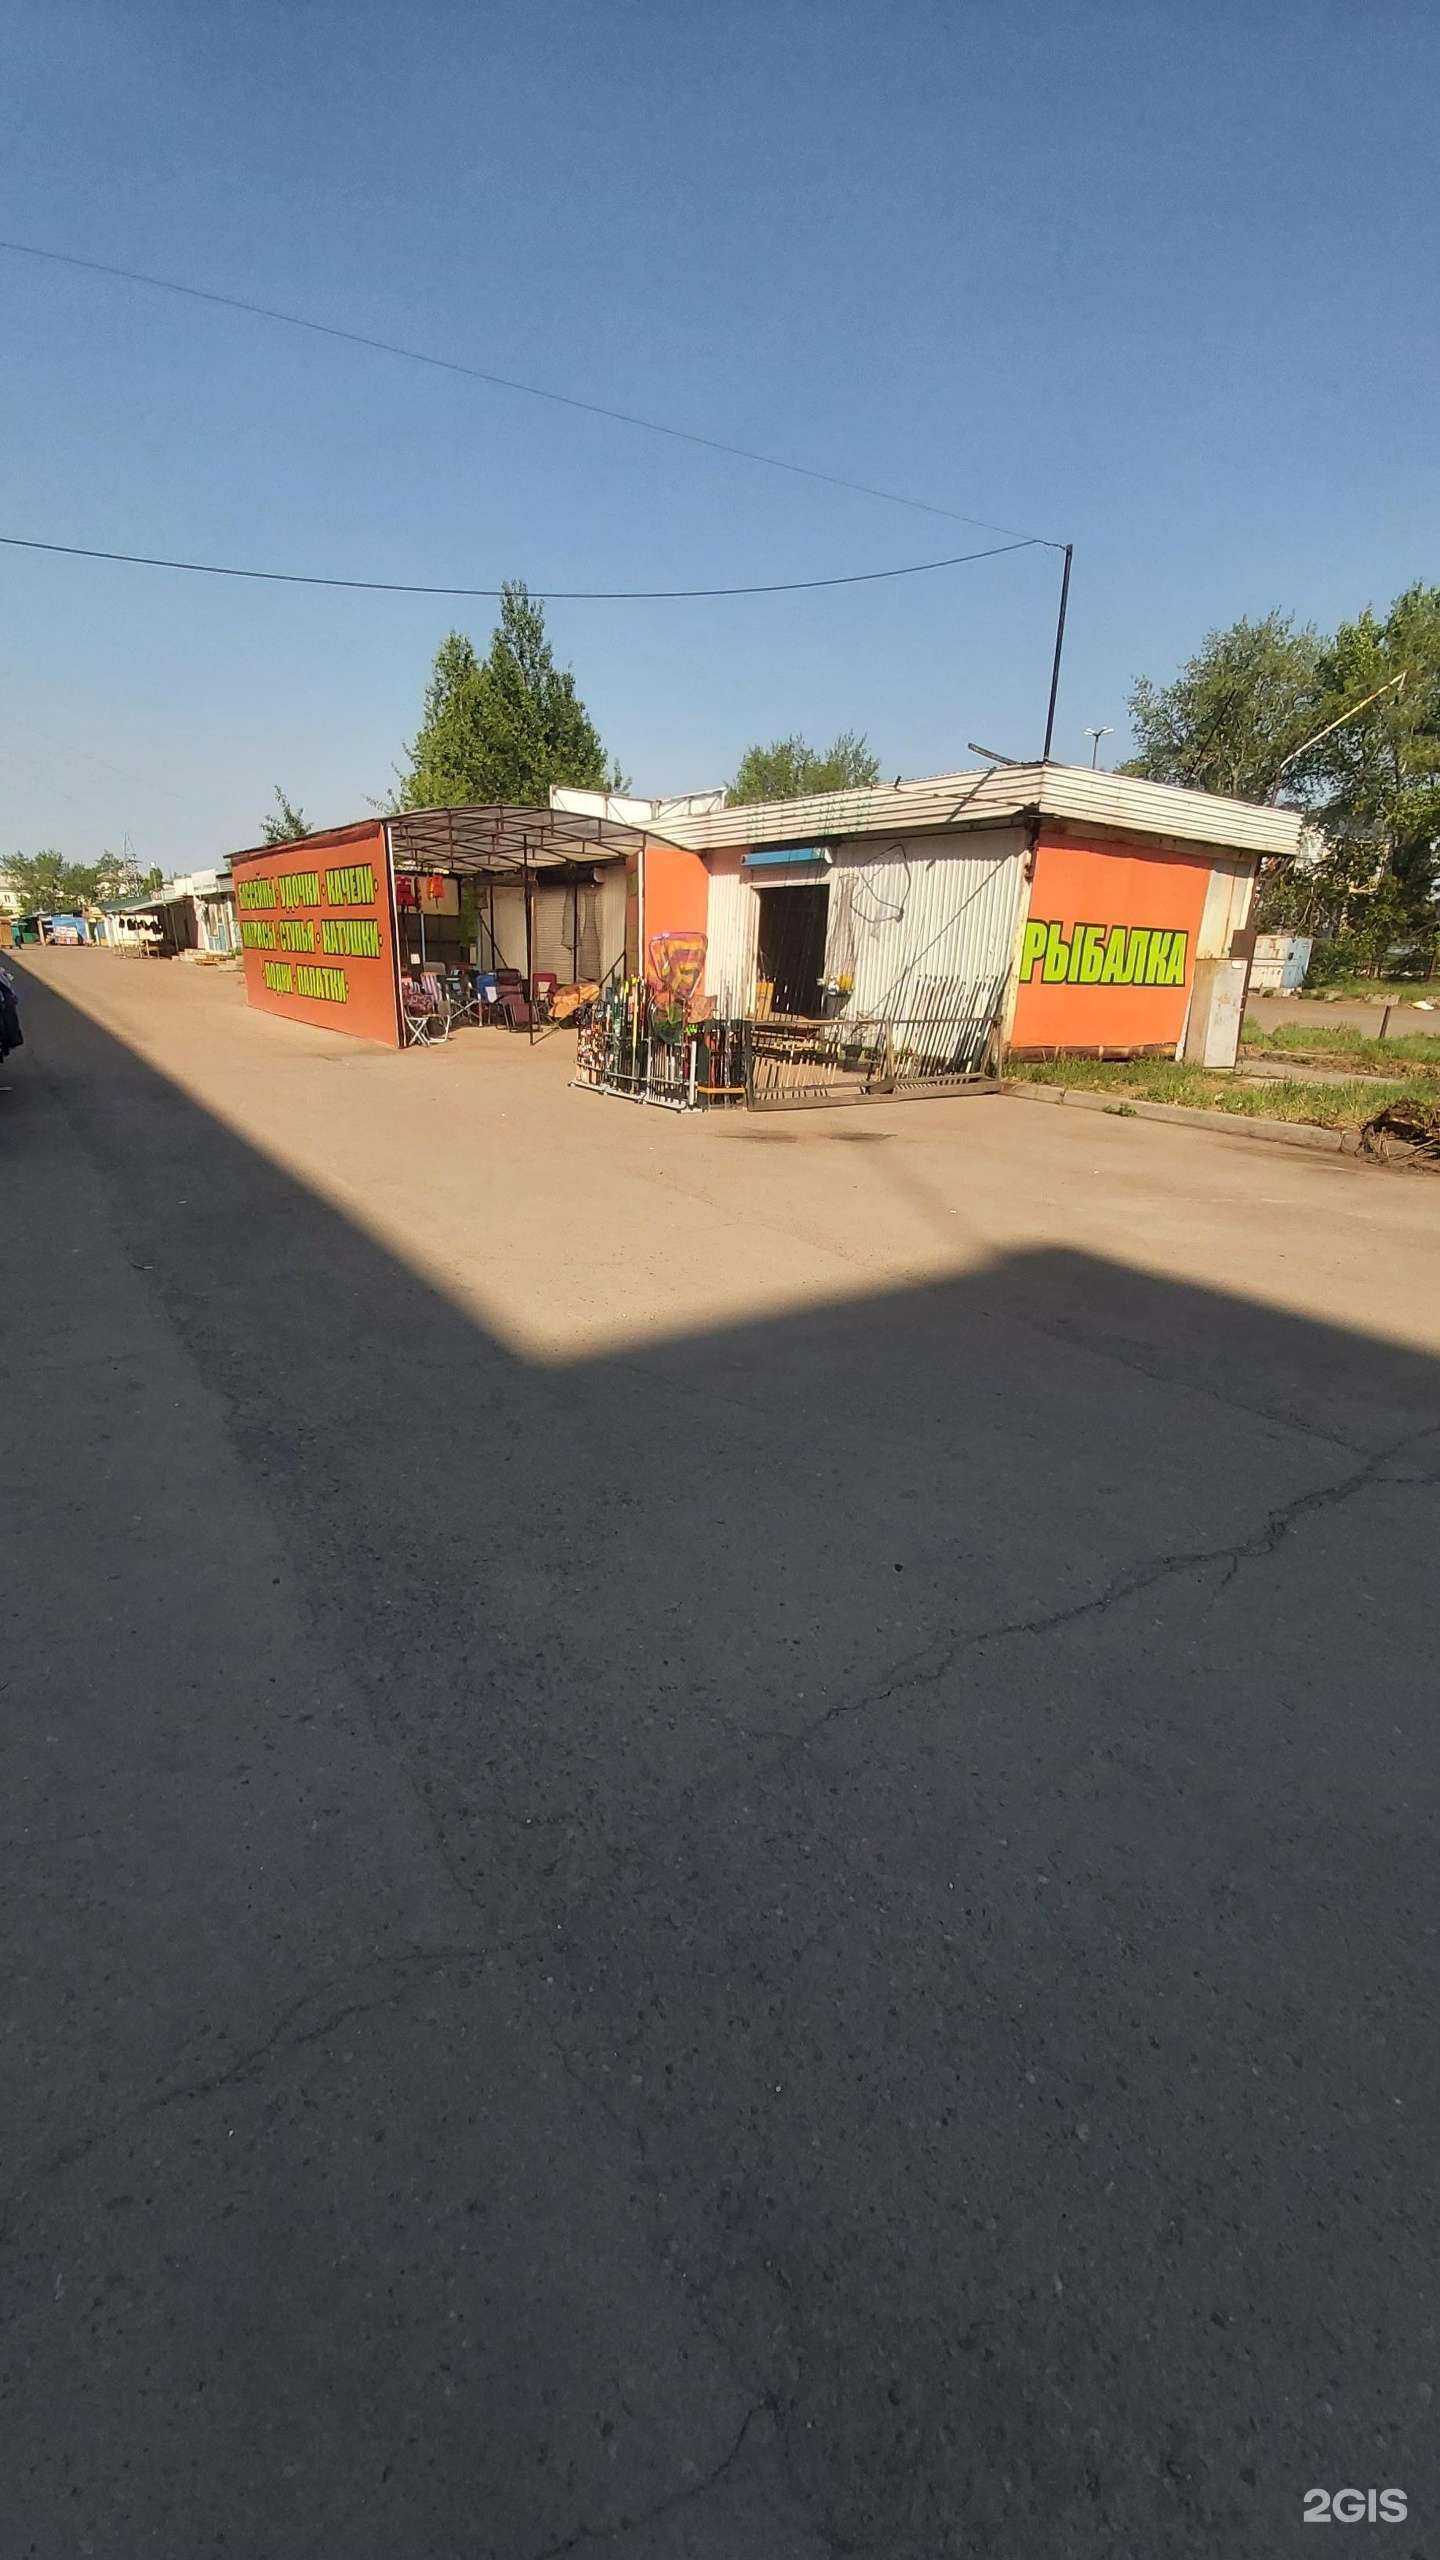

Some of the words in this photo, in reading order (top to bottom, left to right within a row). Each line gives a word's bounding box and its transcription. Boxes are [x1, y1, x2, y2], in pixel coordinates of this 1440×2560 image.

[278, 871, 321, 913] УДОЧКИ
[325, 863, 375, 906] КАЧЕЛИ
[279, 919, 315, 953] СТУЛЬЯ
[321, 919, 380, 958] КАТУШКИ
[1019, 919, 1188, 987] РЫБАЛКА
[296, 963, 346, 1004] ПАЛАТКИ
